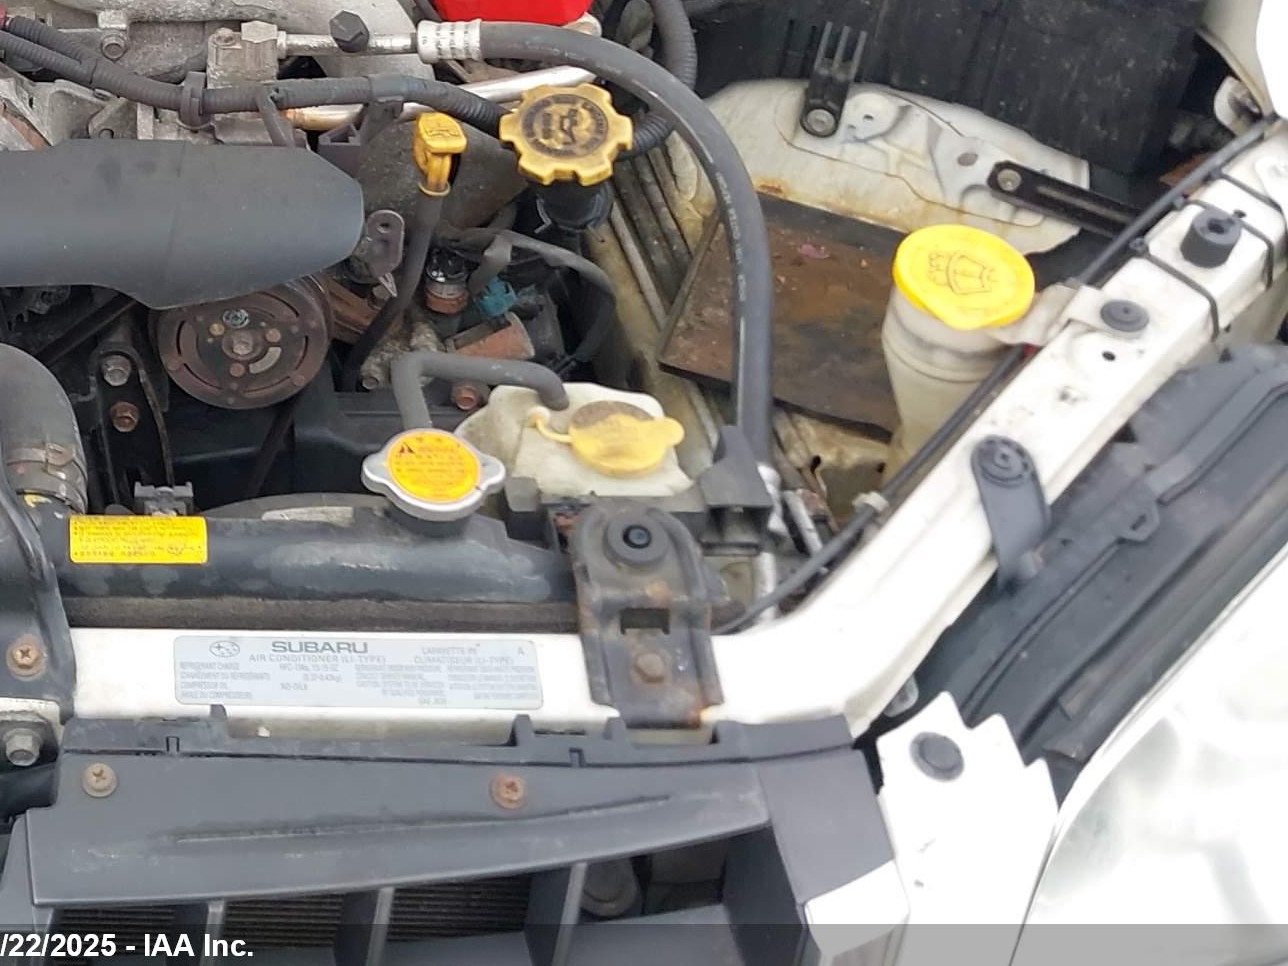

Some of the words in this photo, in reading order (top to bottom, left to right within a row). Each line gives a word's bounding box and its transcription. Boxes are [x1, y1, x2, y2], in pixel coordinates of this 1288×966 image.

[271, 640, 368, 654] SUBARU
[249, 653, 267, 663] AIR
[269, 653, 339, 664] CONDITIONER
